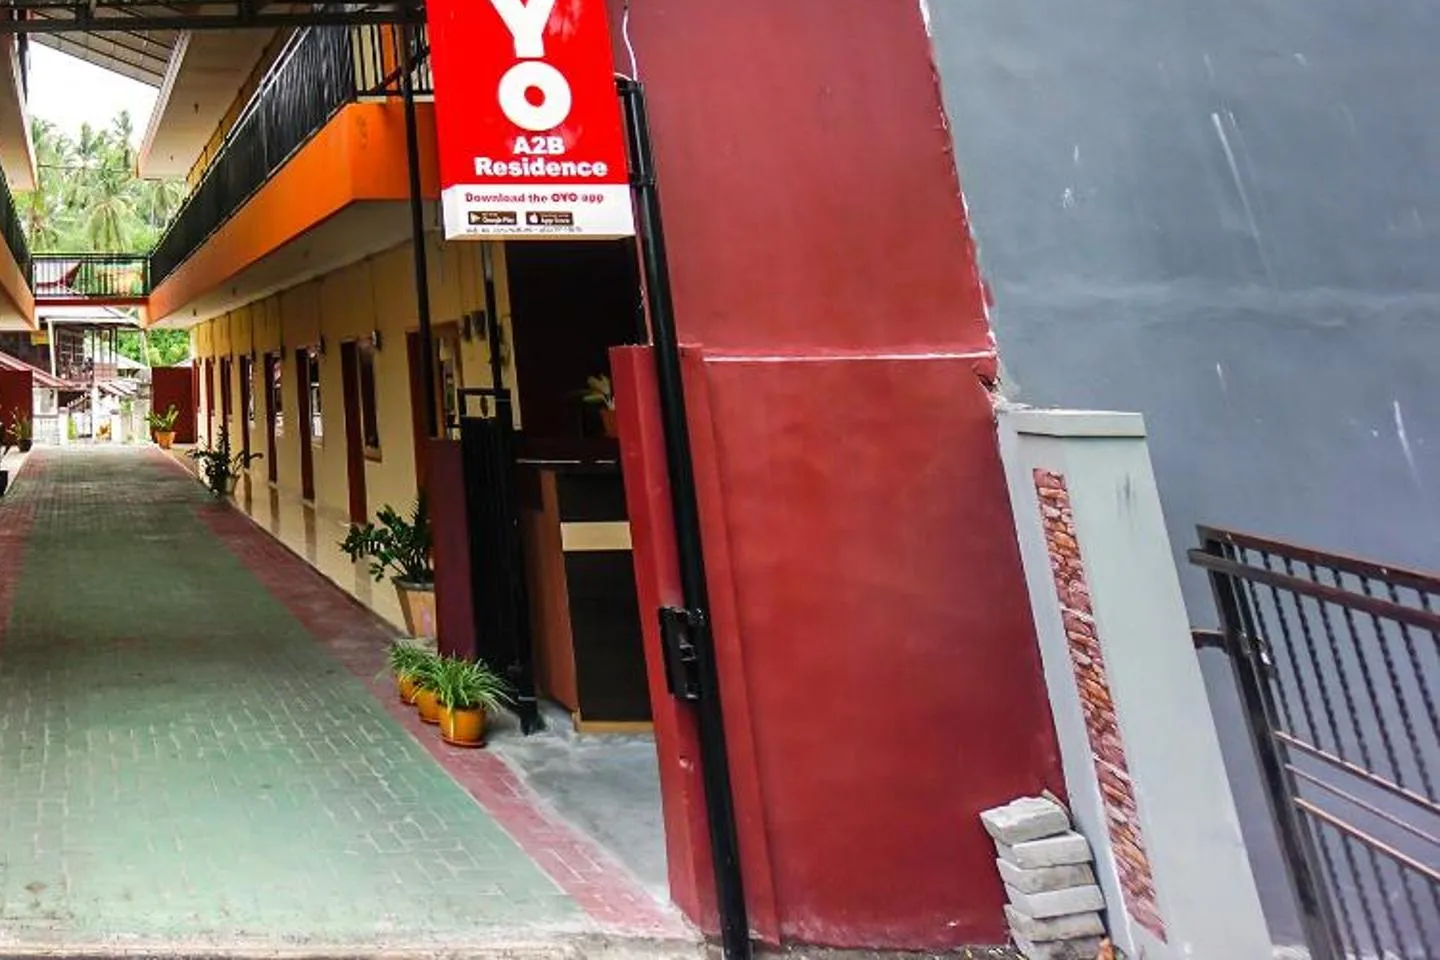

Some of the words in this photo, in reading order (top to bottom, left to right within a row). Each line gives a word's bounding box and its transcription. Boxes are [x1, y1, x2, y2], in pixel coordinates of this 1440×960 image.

[513, 136, 565, 155] A2B
[474, 157, 608, 178] Residence
[465, 192, 525, 203] Download
[529, 193, 548, 204] the
[551, 193, 578, 203] OYO
[581, 195, 604, 205] app
